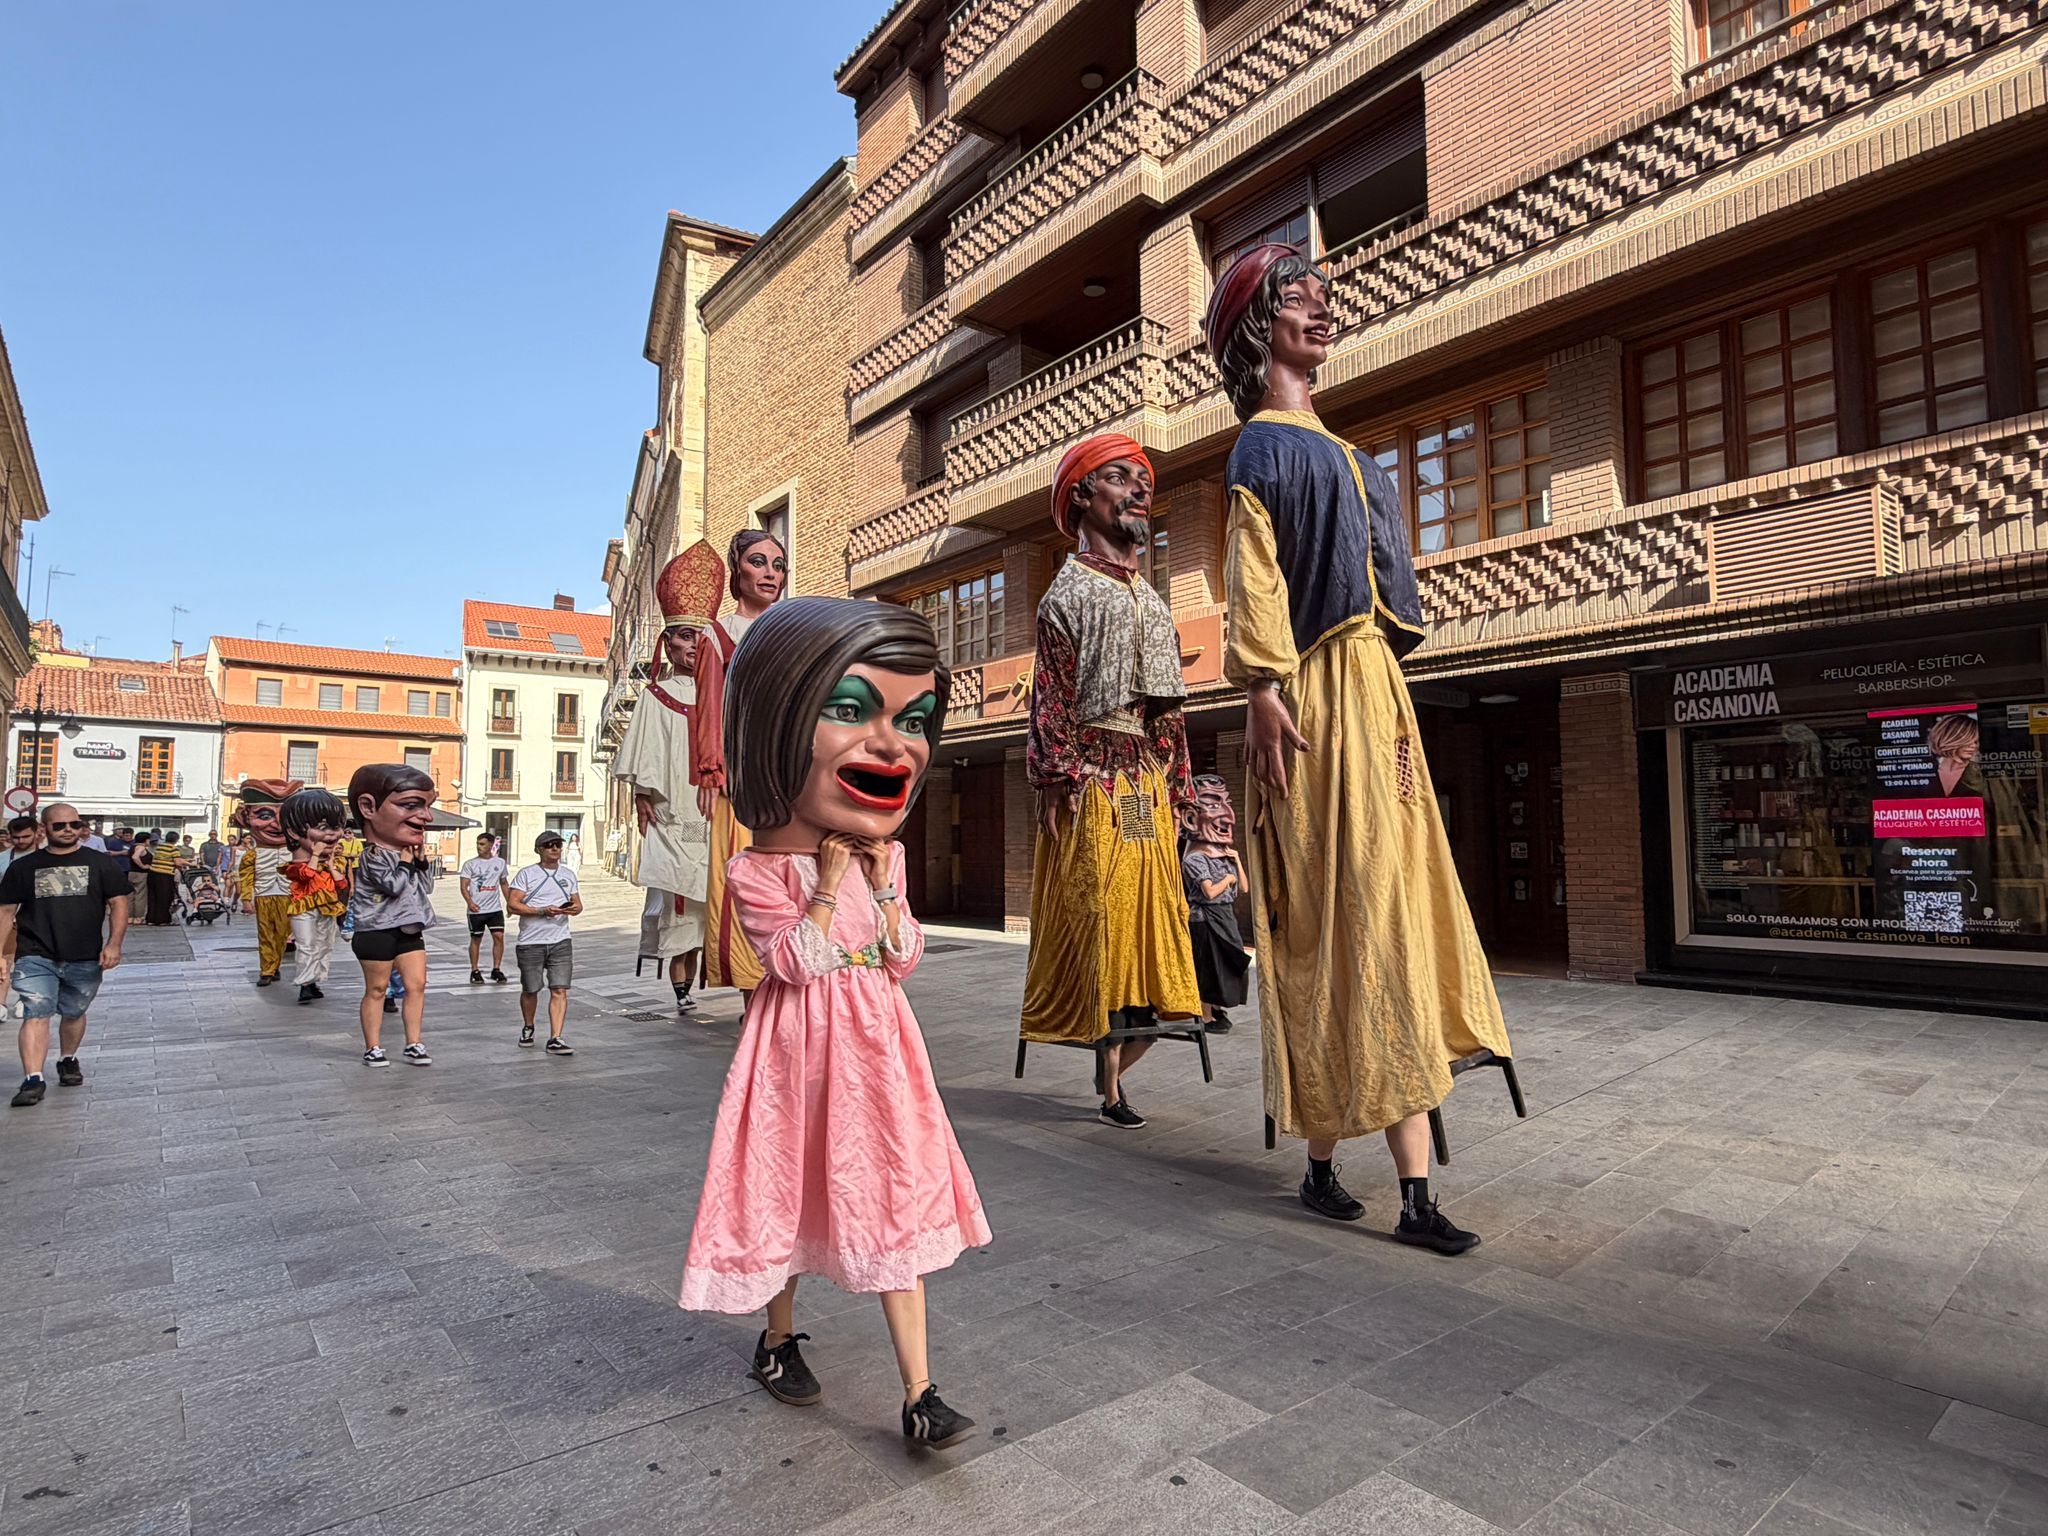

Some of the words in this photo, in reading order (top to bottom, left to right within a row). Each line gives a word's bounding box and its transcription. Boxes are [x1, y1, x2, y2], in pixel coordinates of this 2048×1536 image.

[1918, 654, 1985, 671] ESTÉTICA
[1673, 663, 1775, 695] ACADEMIA
[1674, 691, 1781, 722] CASANOVA
[1881, 718, 1920, 728] ACADEMIA
[1882, 730, 1920, 740] CASANOVA
[1877, 748, 1901, 757] CORTE
[1902, 746, 1929, 756] GRATIS
[1980, 750, 2042, 761] HORARIO
[1876, 764, 1897, 772] TINTE
[1902, 762, 1933, 771] PEINADO
[1874, 809, 1923, 821] ACADEMIA
[1926, 808, 1980, 819] CASANOVA
[1901, 846, 1957, 856] Reservar
[1911, 858, 1948, 867] ahora
[1726, 913, 1757, 923] SOLO
[1760, 915, 1838, 926] TRABAJAMOS
[1841, 918, 1869, 927] CON
[1769, 926, 1971, 945] @academia_casanova_leon
